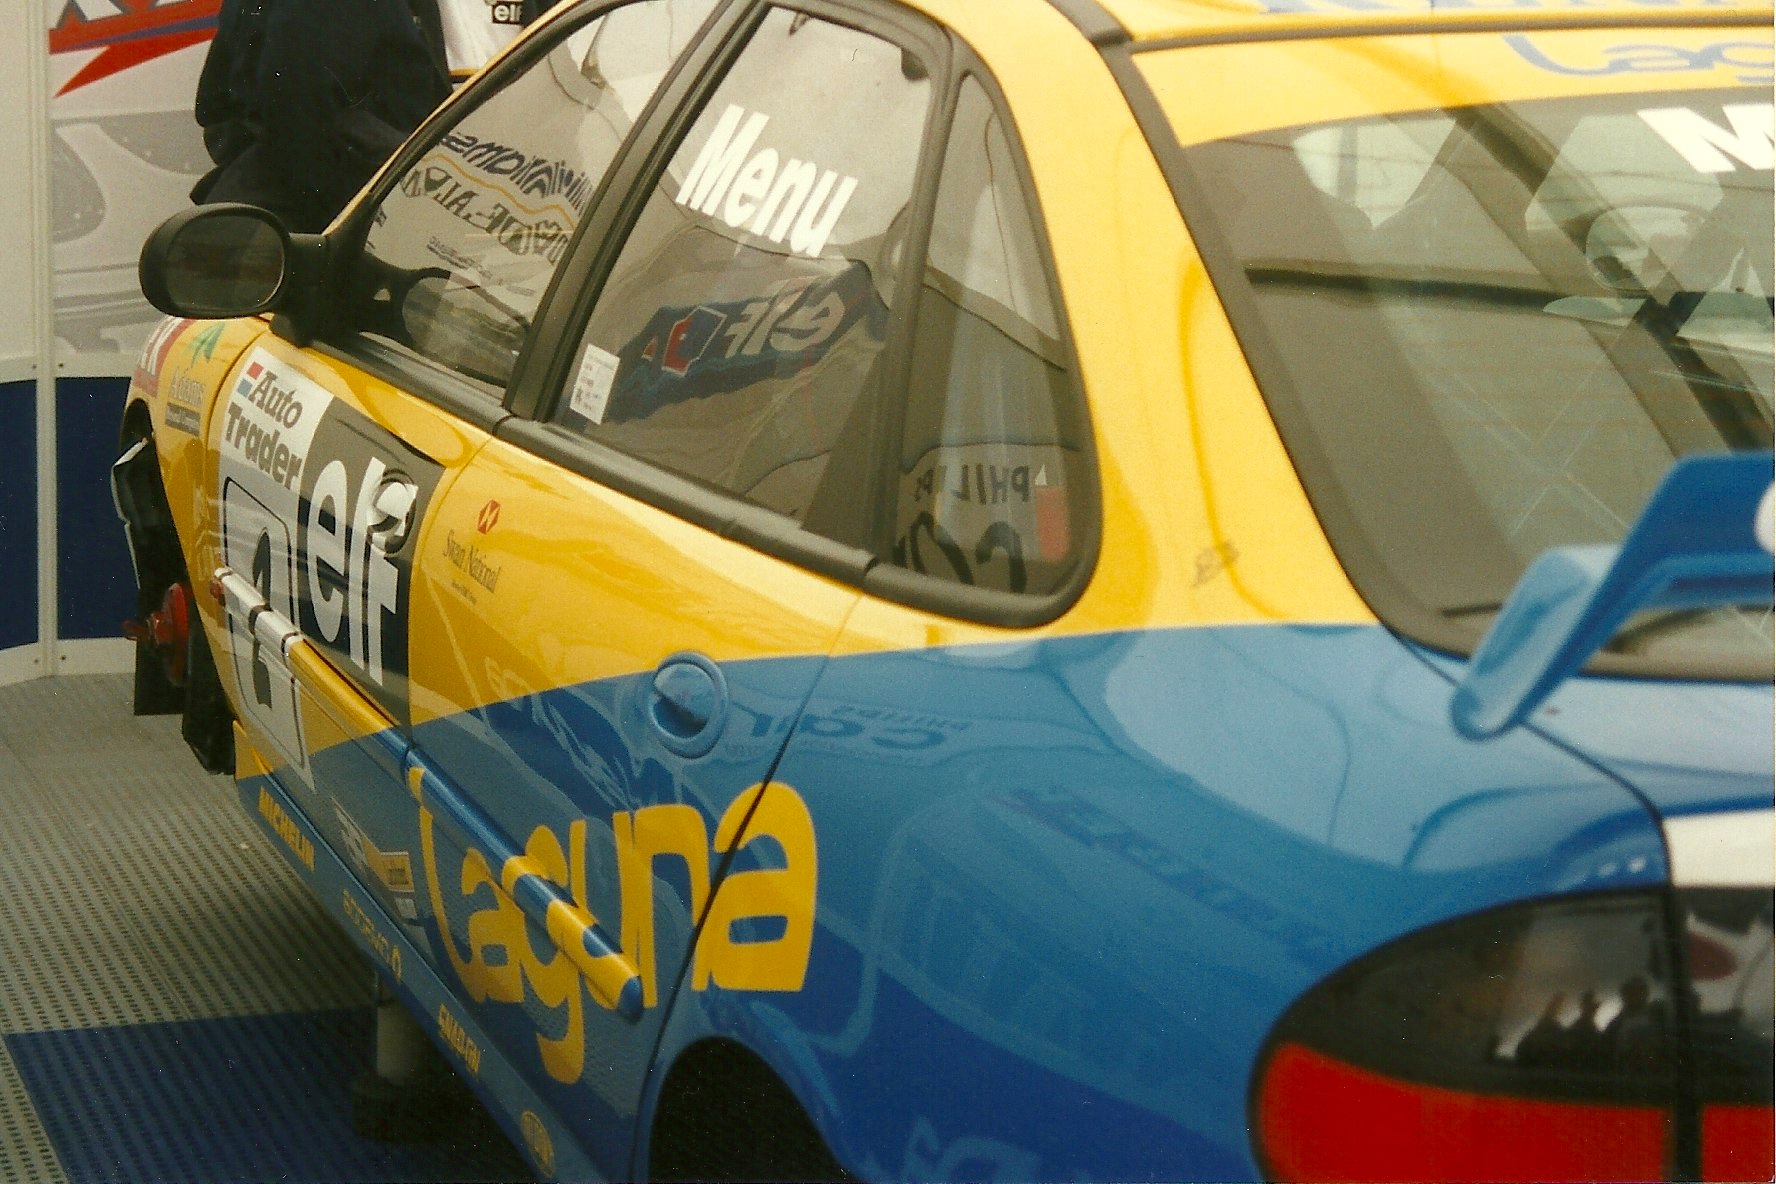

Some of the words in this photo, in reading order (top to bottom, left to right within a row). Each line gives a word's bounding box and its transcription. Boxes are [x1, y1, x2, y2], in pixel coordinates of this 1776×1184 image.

[675, 103, 858, 258] Menu
[225, 401, 303, 491] Trader
[248, 369, 303, 429] Auto
[307, 455, 419, 687] elf
[407, 767, 818, 1085] Laguna
